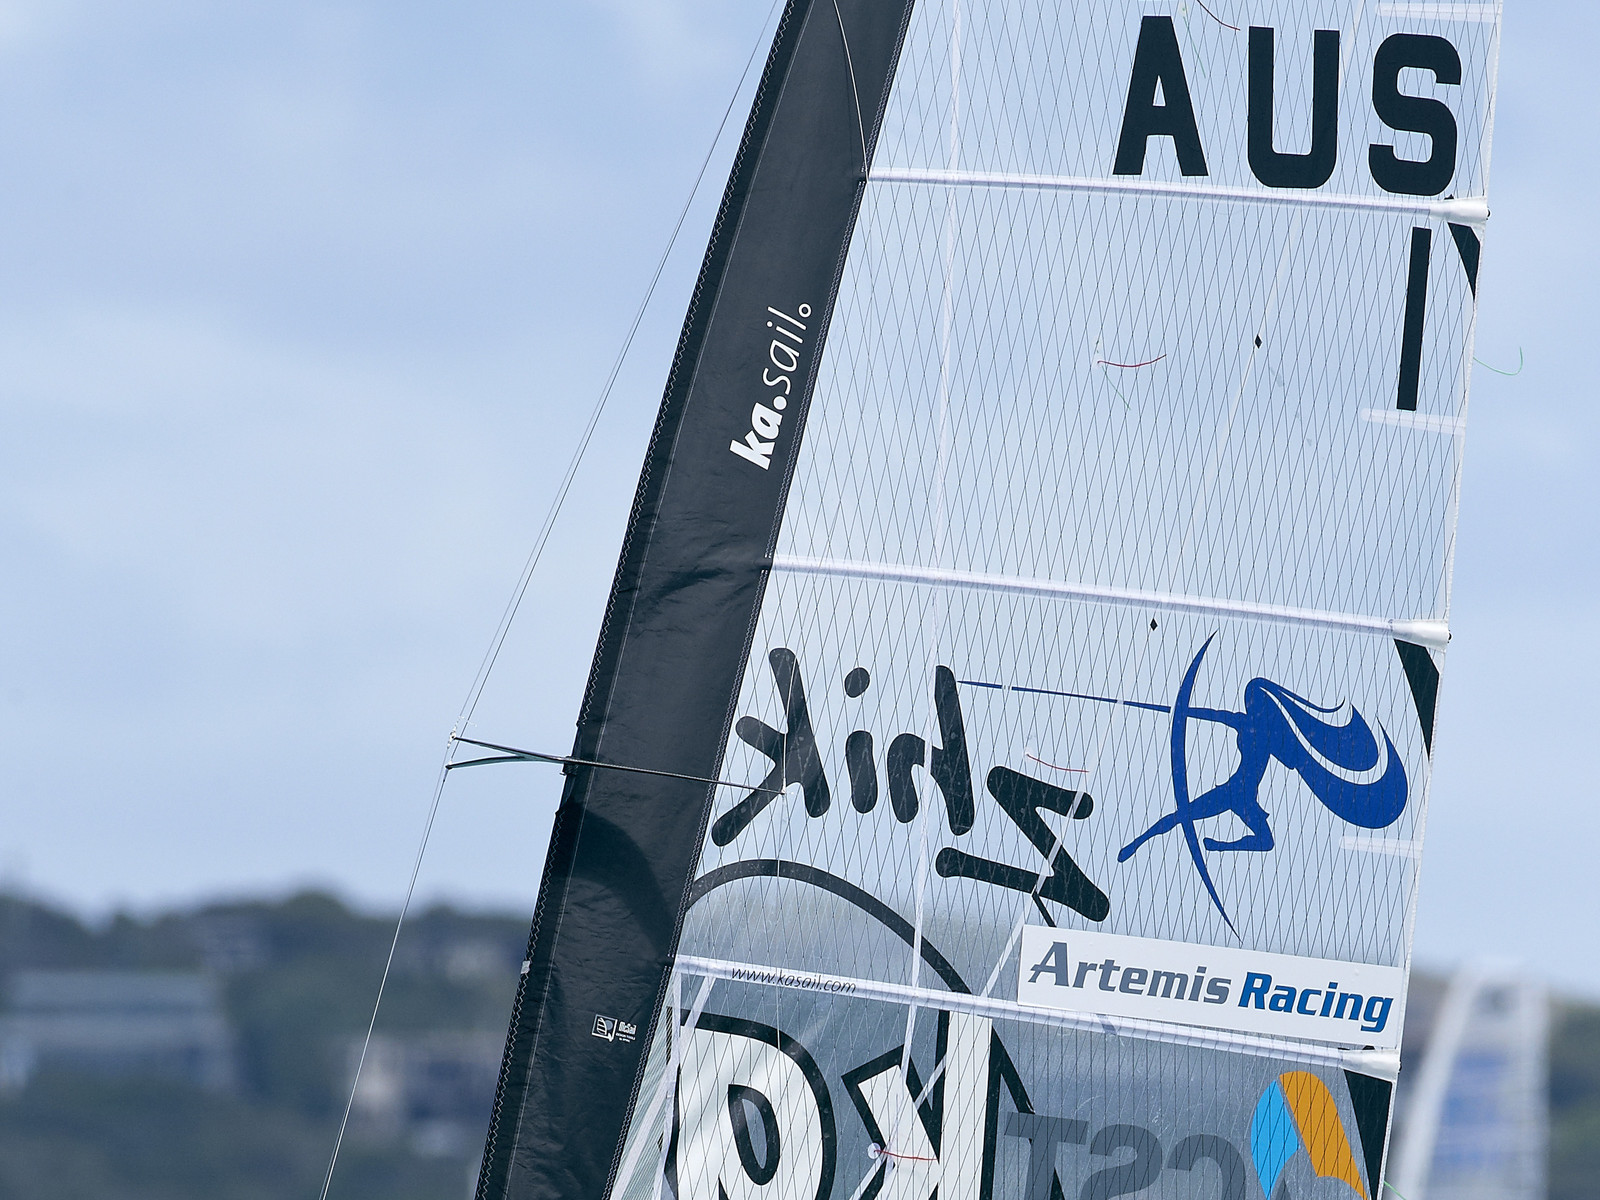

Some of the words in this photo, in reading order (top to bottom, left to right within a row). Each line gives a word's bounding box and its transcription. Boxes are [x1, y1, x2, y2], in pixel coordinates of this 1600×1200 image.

[1113, 15, 1462, 196] AUS
[732, 967, 856, 993] www.kasail.com
[1028, 941, 1231, 1004] Artemis
[1238, 973, 1393, 1032] Racing
